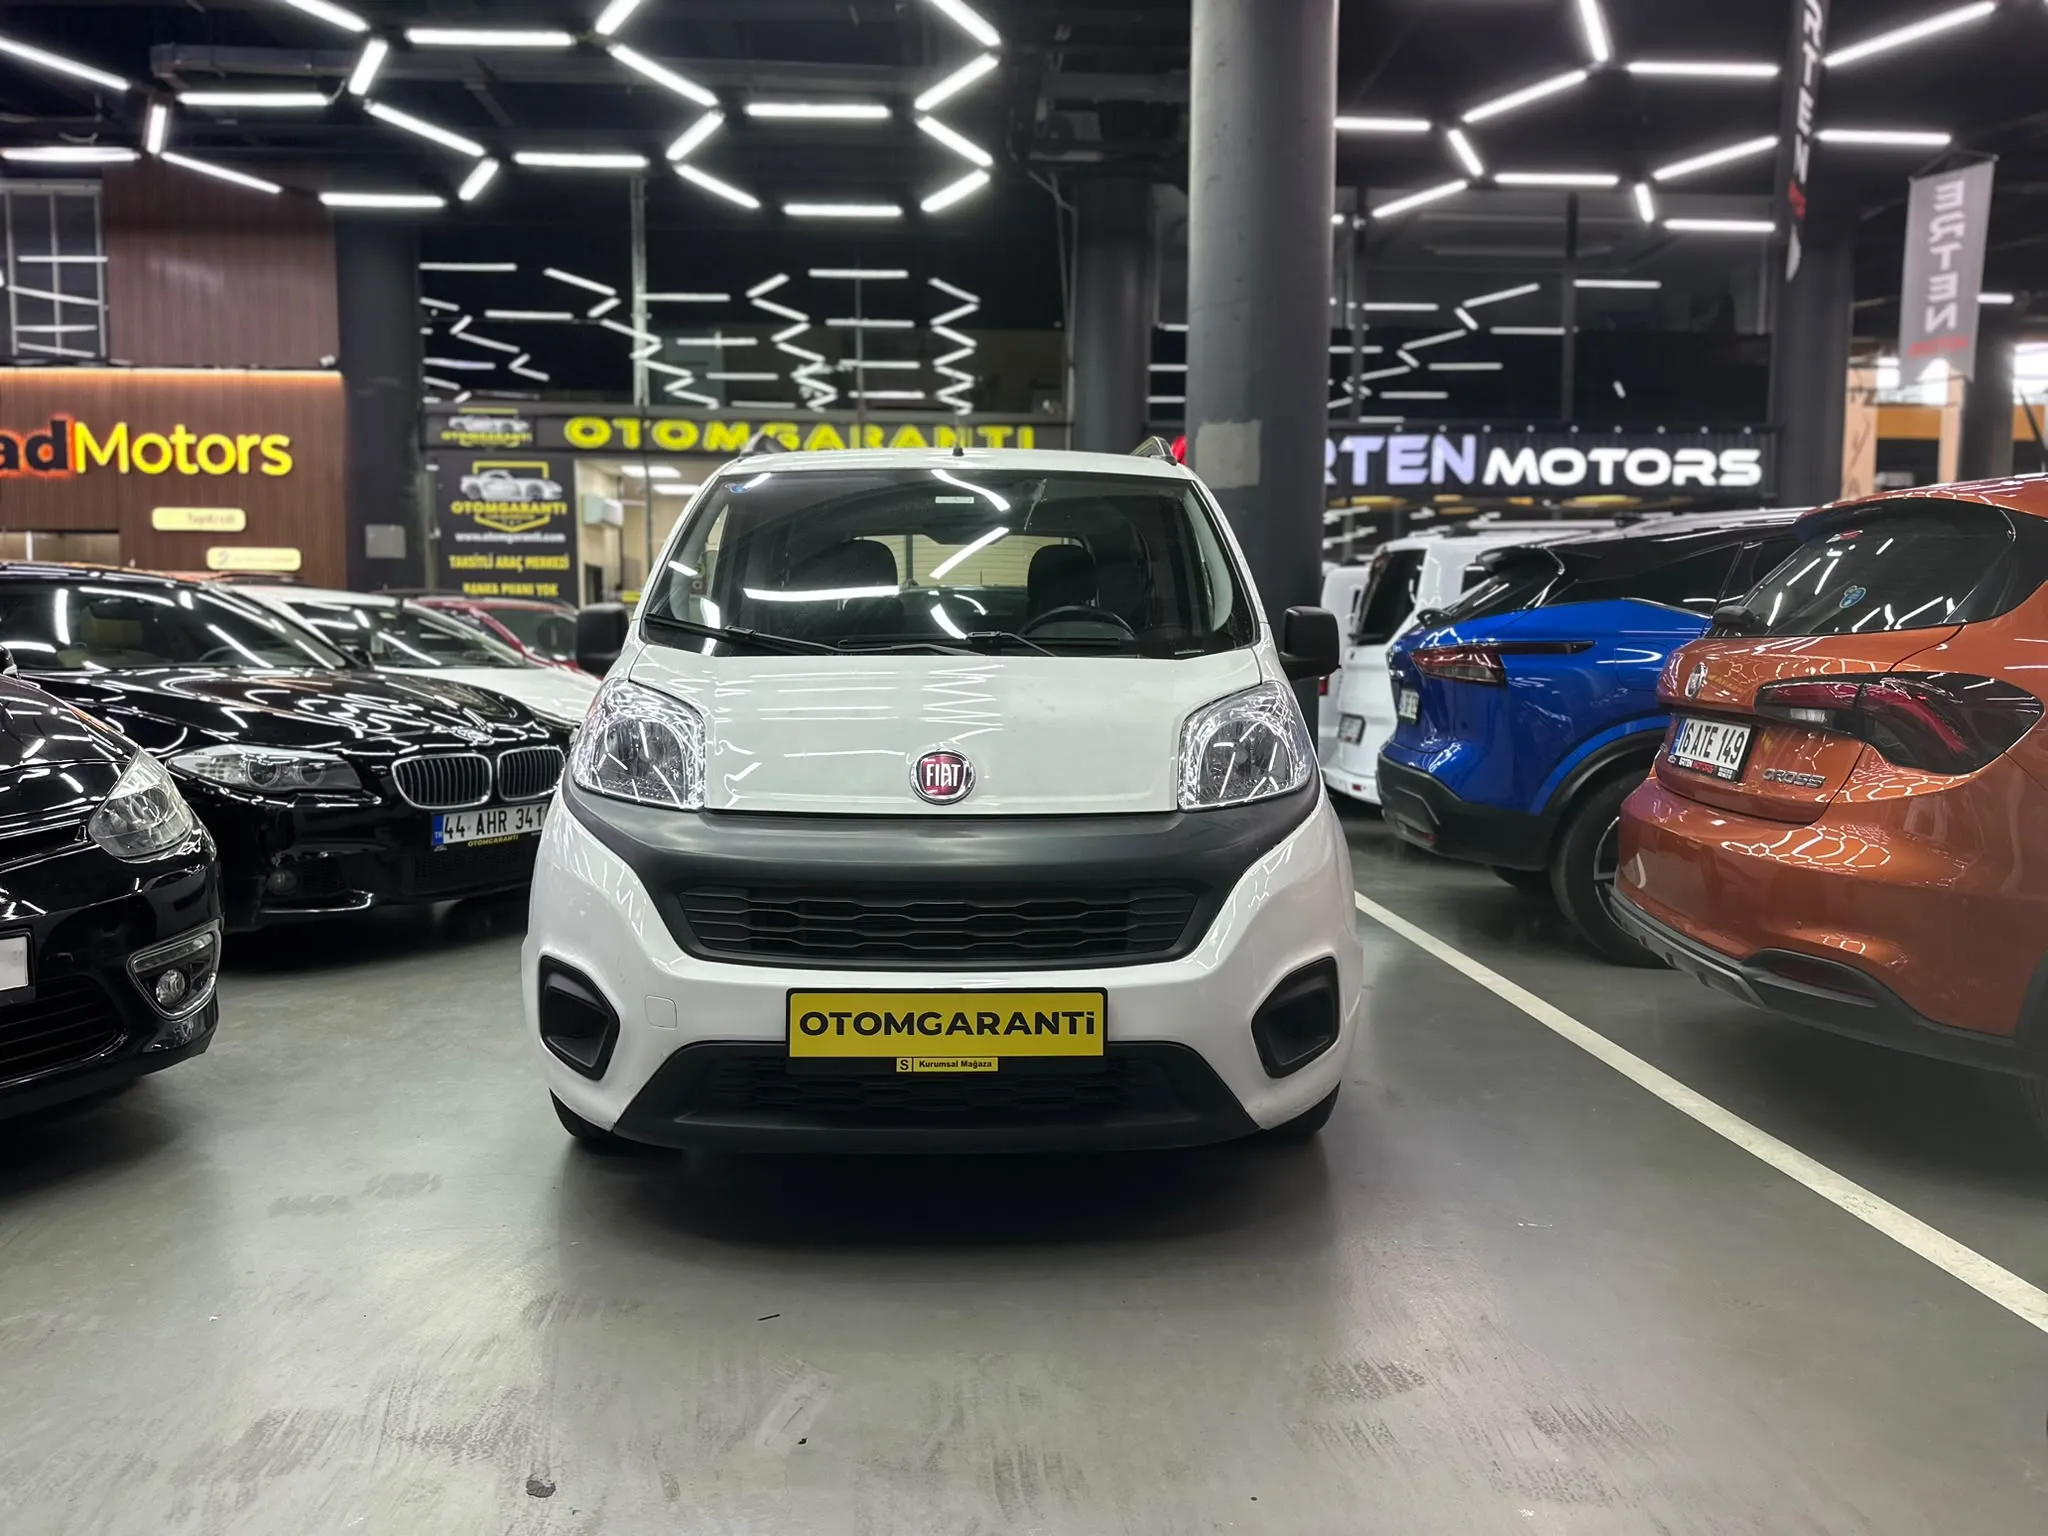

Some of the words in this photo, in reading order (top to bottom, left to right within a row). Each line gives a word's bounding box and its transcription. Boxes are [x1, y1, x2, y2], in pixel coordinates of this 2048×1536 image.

[1481, 447, 1763, 486] MOTORS
[450, 500, 567, 514] OTOMGARANTI
[1678, 723, 1695, 750] 16
[1691, 724, 1719, 759] ATE
[1717, 727, 1745, 765] 149
[925, 762, 961, 788] FIAT
[1761, 768, 1827, 788] CROSS
[444, 815, 466, 840] 44
[476, 810, 508, 836] AHR
[899, 1059, 910, 1071] S
[918, 1059, 959, 1070] Kurumsal
[959, 1059, 993, 1071] Mağaza
